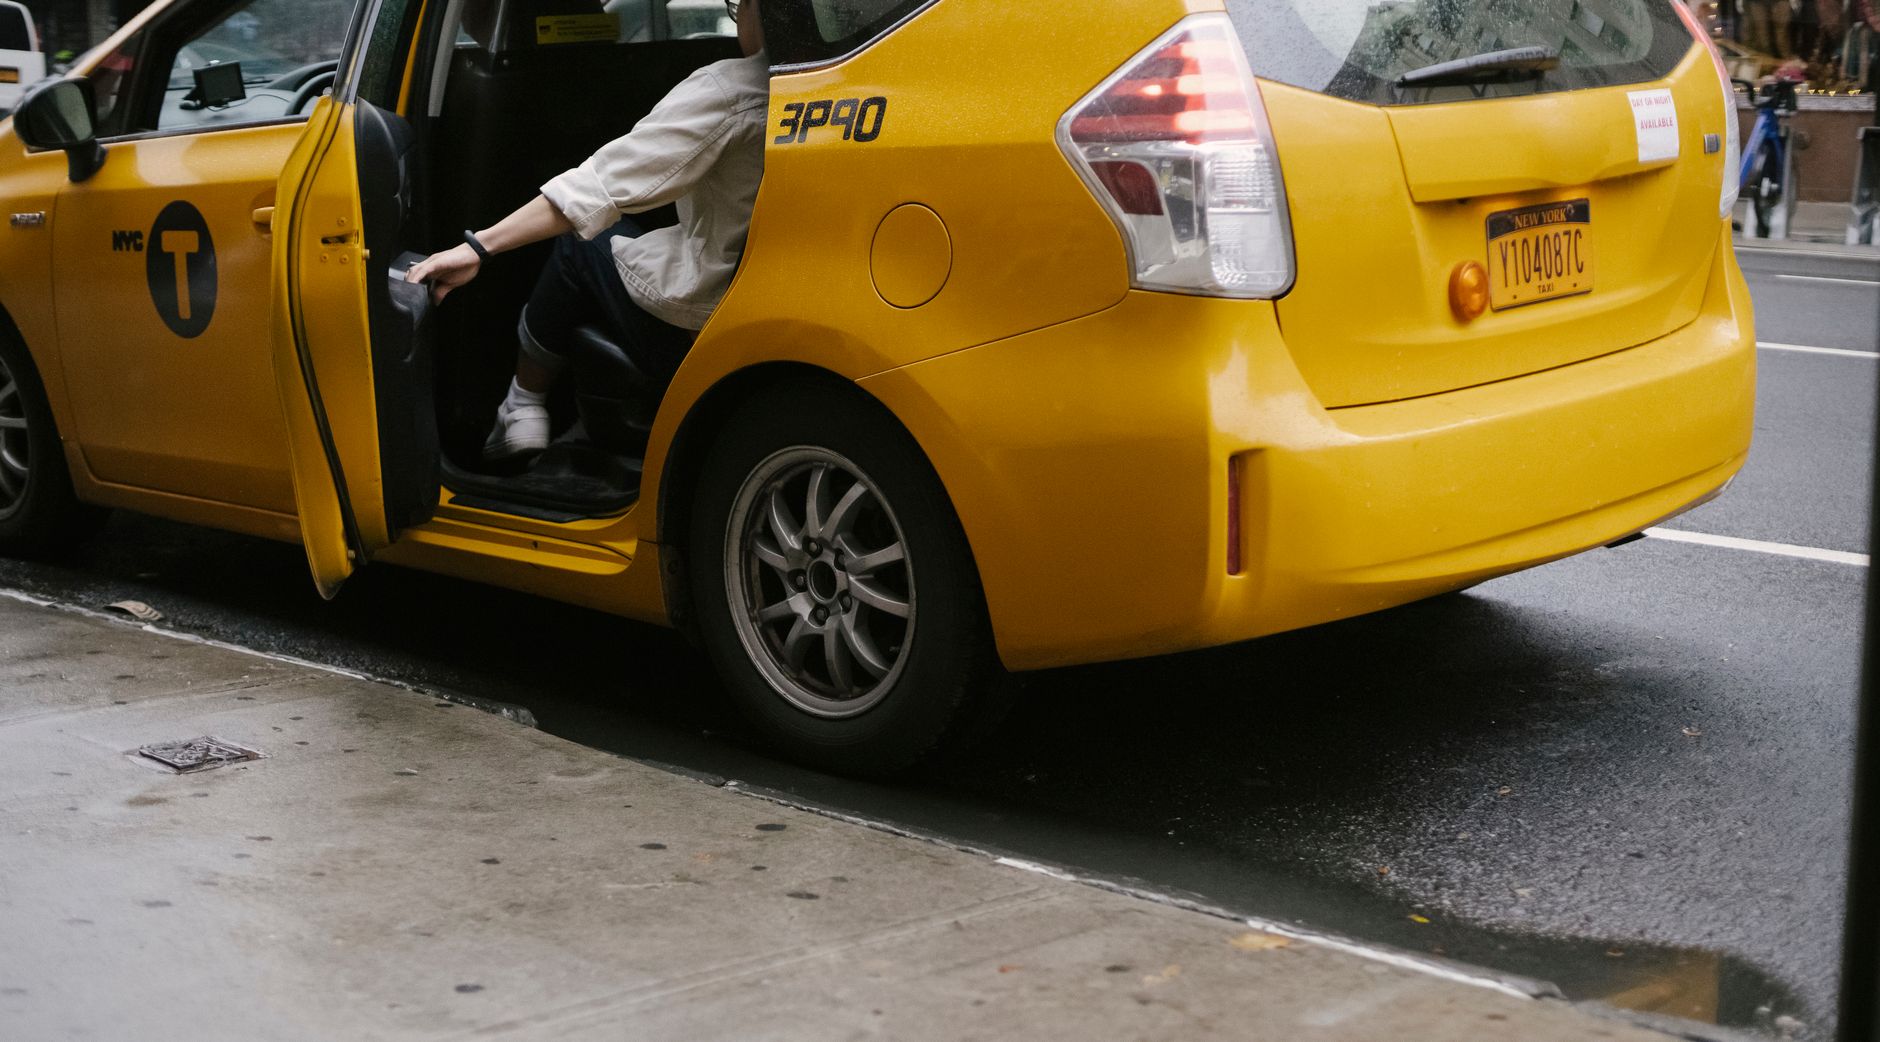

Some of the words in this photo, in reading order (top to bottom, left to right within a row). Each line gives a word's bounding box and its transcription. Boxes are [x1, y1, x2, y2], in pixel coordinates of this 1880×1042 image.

[1654, 95, 1671, 105] NIGHT
[774, 96, 887, 144] 3P90
[1641, 117, 1673, 130] AVAILABLE
[1514, 213, 1540, 229] NEW
[1541, 207, 1567, 223] YORK
[1499, 229, 1584, 288] Y104087C
[112, 230, 144, 252] NYC
[161, 230, 199, 320] T
[1537, 283, 1555, 294] TAXI
